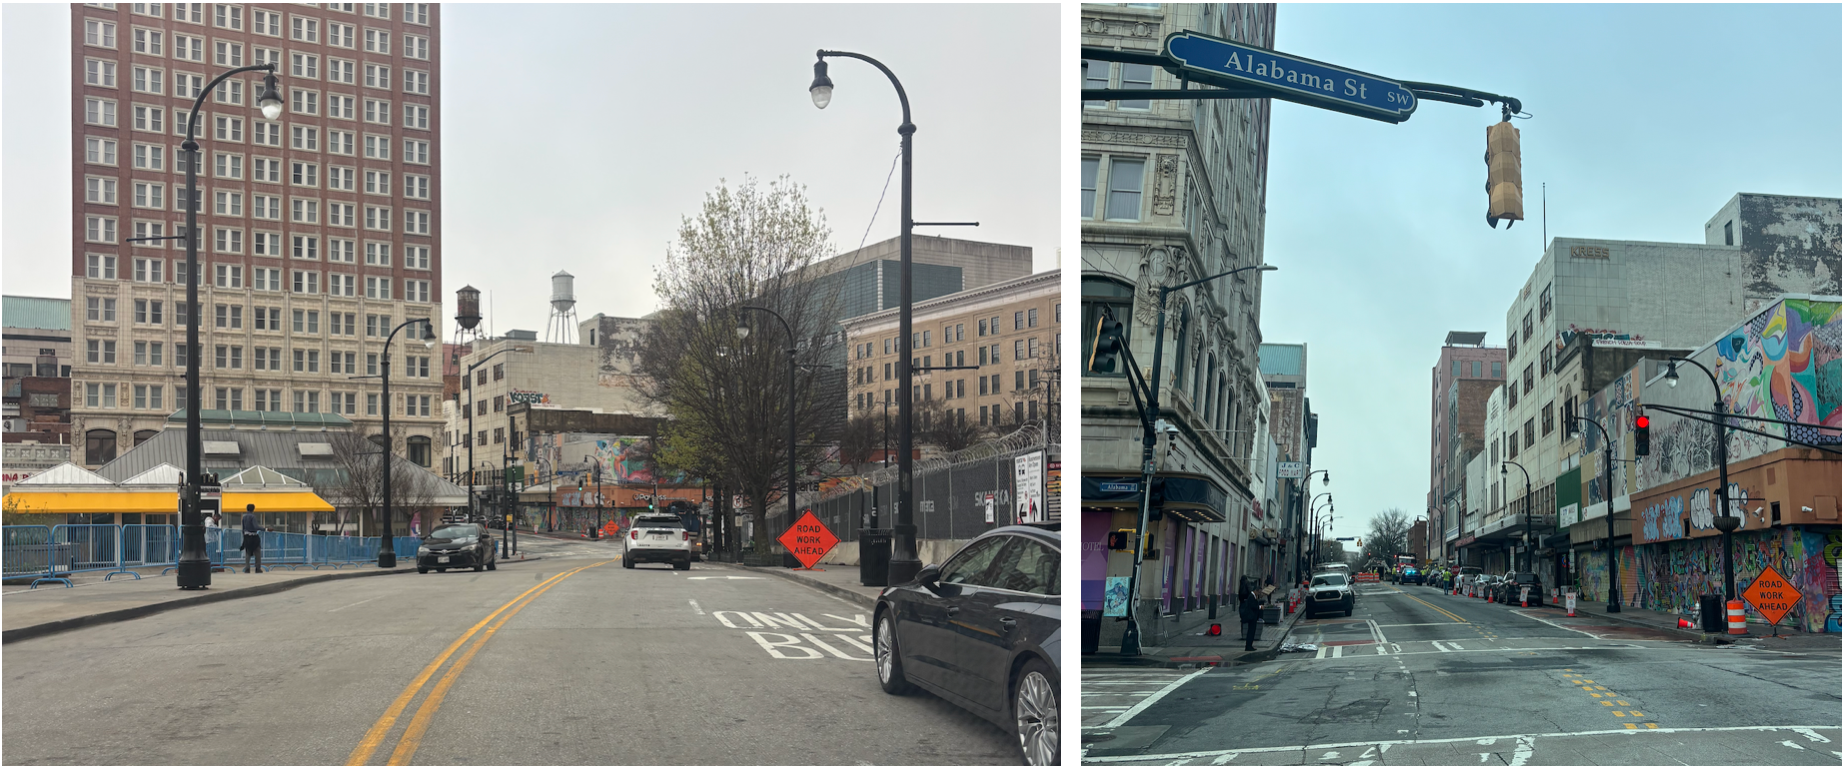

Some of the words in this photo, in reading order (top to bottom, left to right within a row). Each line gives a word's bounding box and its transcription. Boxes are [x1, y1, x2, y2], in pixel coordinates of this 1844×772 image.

[1224, 51, 1335, 93] Alabama
[1344, 78, 1368, 100] St
[1387, 91, 1410, 106] SW
[1570, 246, 1610, 259] KRESS
[796, 524, 821, 534] ROAD
[796, 535, 821, 544] WORK
[793, 546, 824, 555] AHEAD
[1082, 541, 1105, 552] OTEL
[1759, 580, 1783, 588] ROAD
[1759, 591, 1784, 600] WORK
[1758, 602, 1789, 611] AHEAD
[712, 610, 873, 632] ONLY
